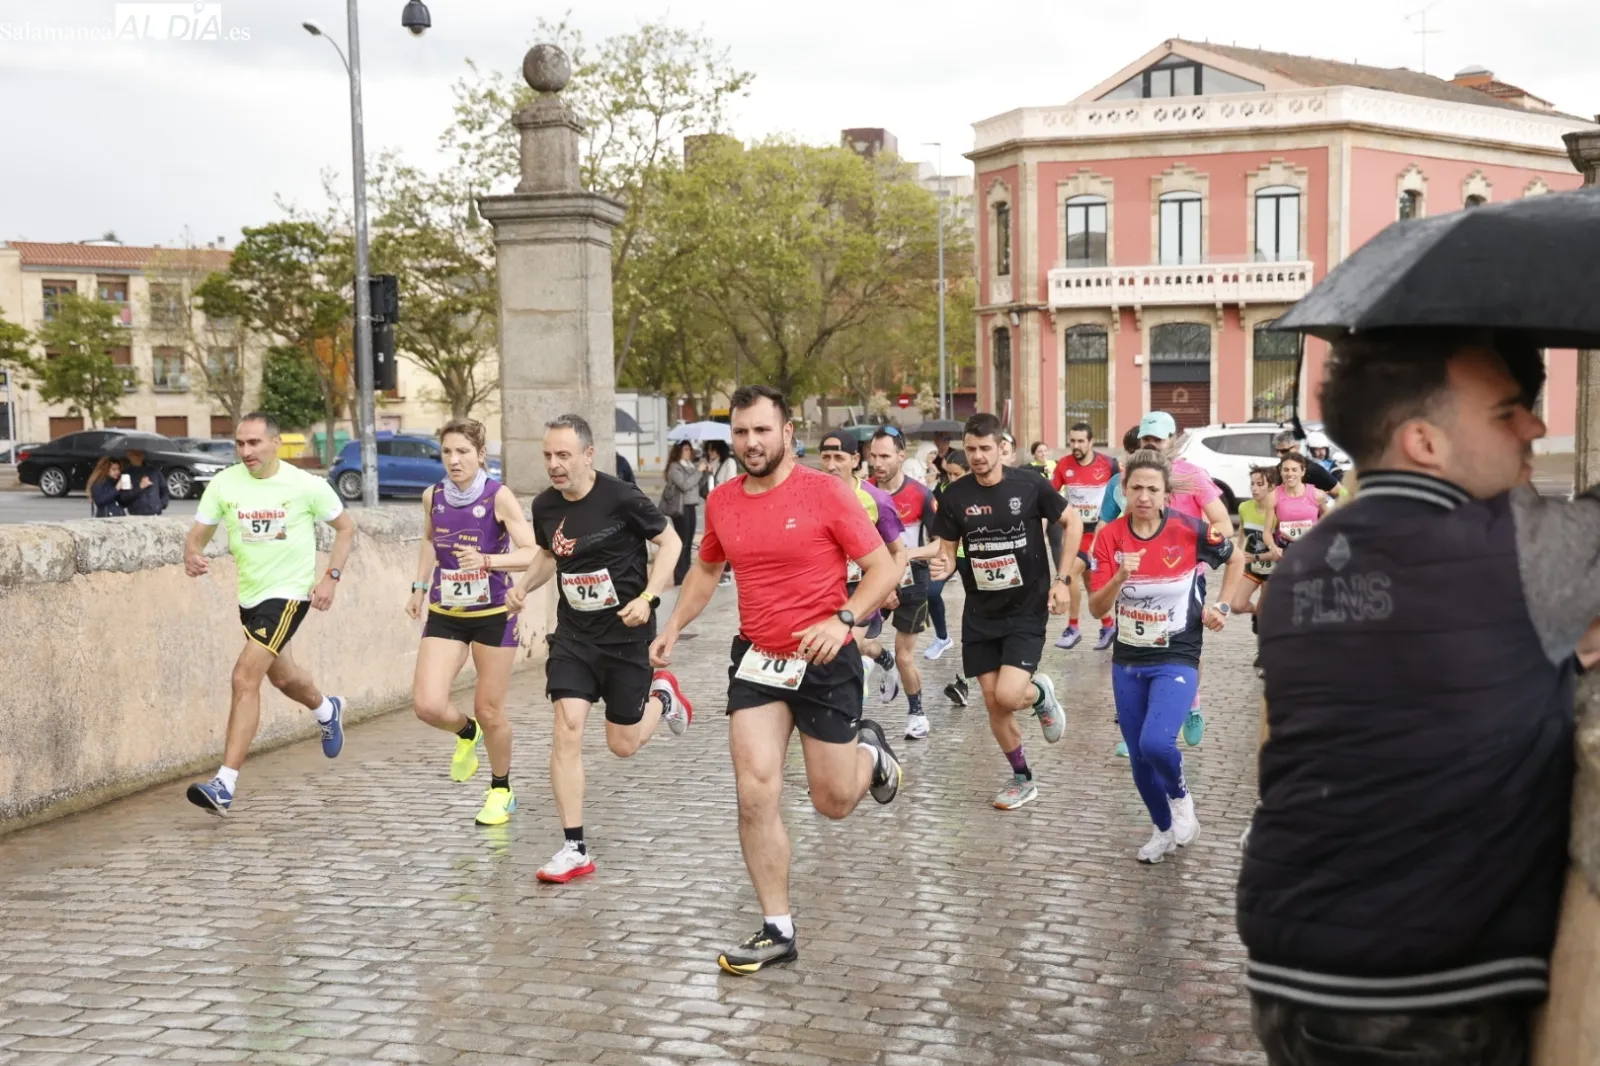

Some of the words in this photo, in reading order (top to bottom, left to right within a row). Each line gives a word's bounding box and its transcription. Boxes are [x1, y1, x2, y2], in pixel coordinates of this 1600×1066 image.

[238, 510, 285, 520] bedunia
[252, 520, 271, 533] 57
[1290, 529, 1302, 537] 81
[972, 558, 1016, 569] bedunia
[1259, 560, 1271, 568] 98
[563, 573, 609, 586] bedunia
[985, 568, 1005, 581] 34
[453, 581, 472, 596] 21
[577, 585, 598, 600] 94
[1120, 606, 1167, 622] bedunia
[1135, 621, 1145, 636] 5
[761, 658, 787, 674] 70
